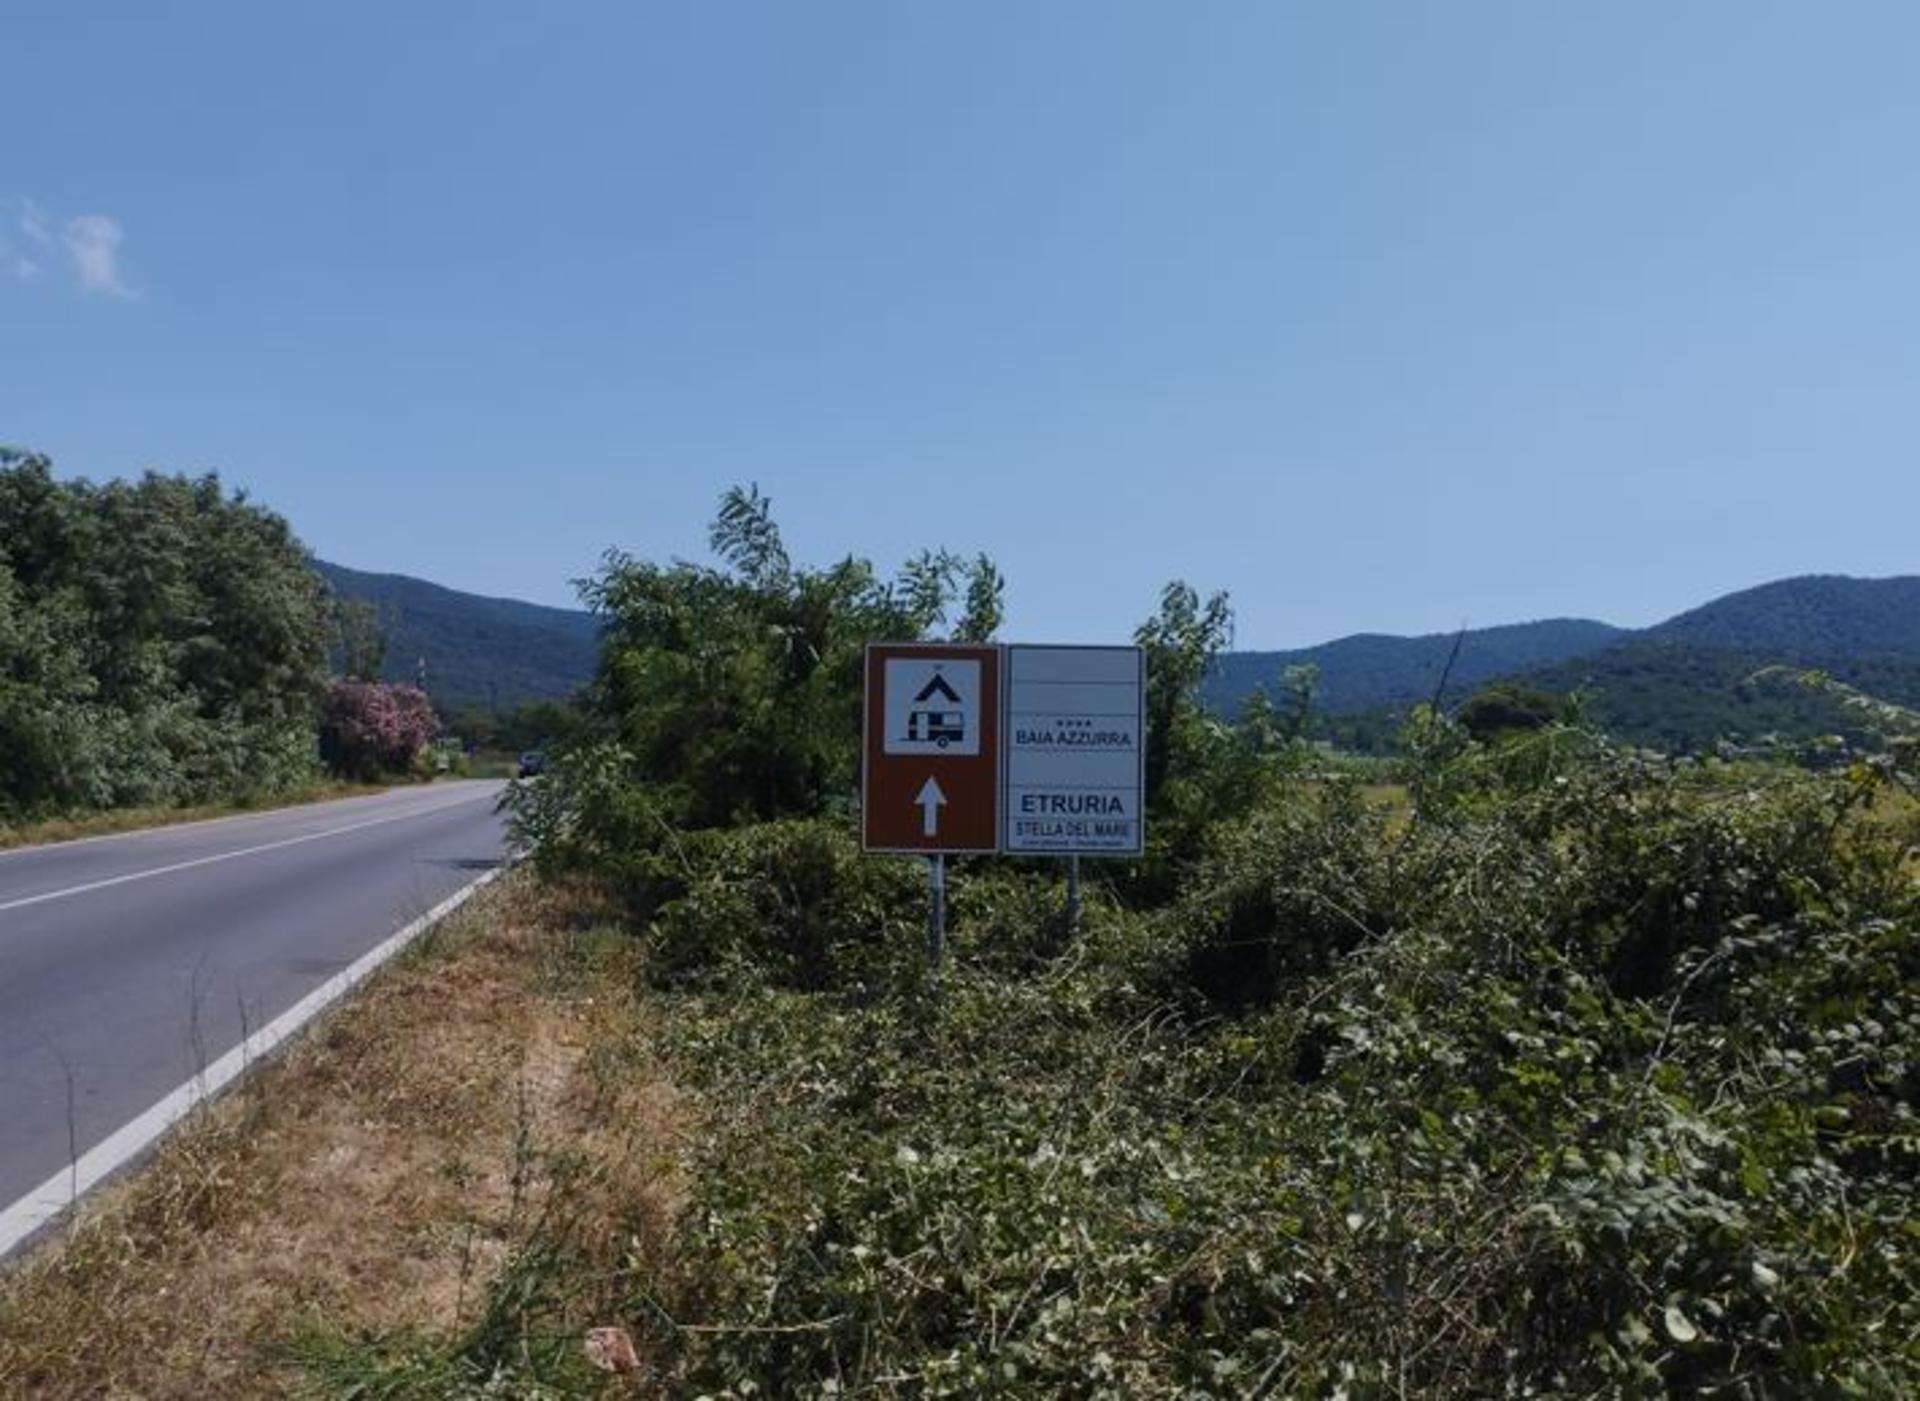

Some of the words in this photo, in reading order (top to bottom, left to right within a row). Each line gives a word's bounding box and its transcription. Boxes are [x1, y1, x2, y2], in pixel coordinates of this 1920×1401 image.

[1016, 730, 1053, 745] BAIA
[1057, 731, 1132, 746] AZZURRA
[1021, 794, 1125, 815] ETRURIA
[1016, 822, 1064, 837] STELLA
[1066, 822, 1089, 837] DEL
[1094, 822, 1130, 838] MARE
